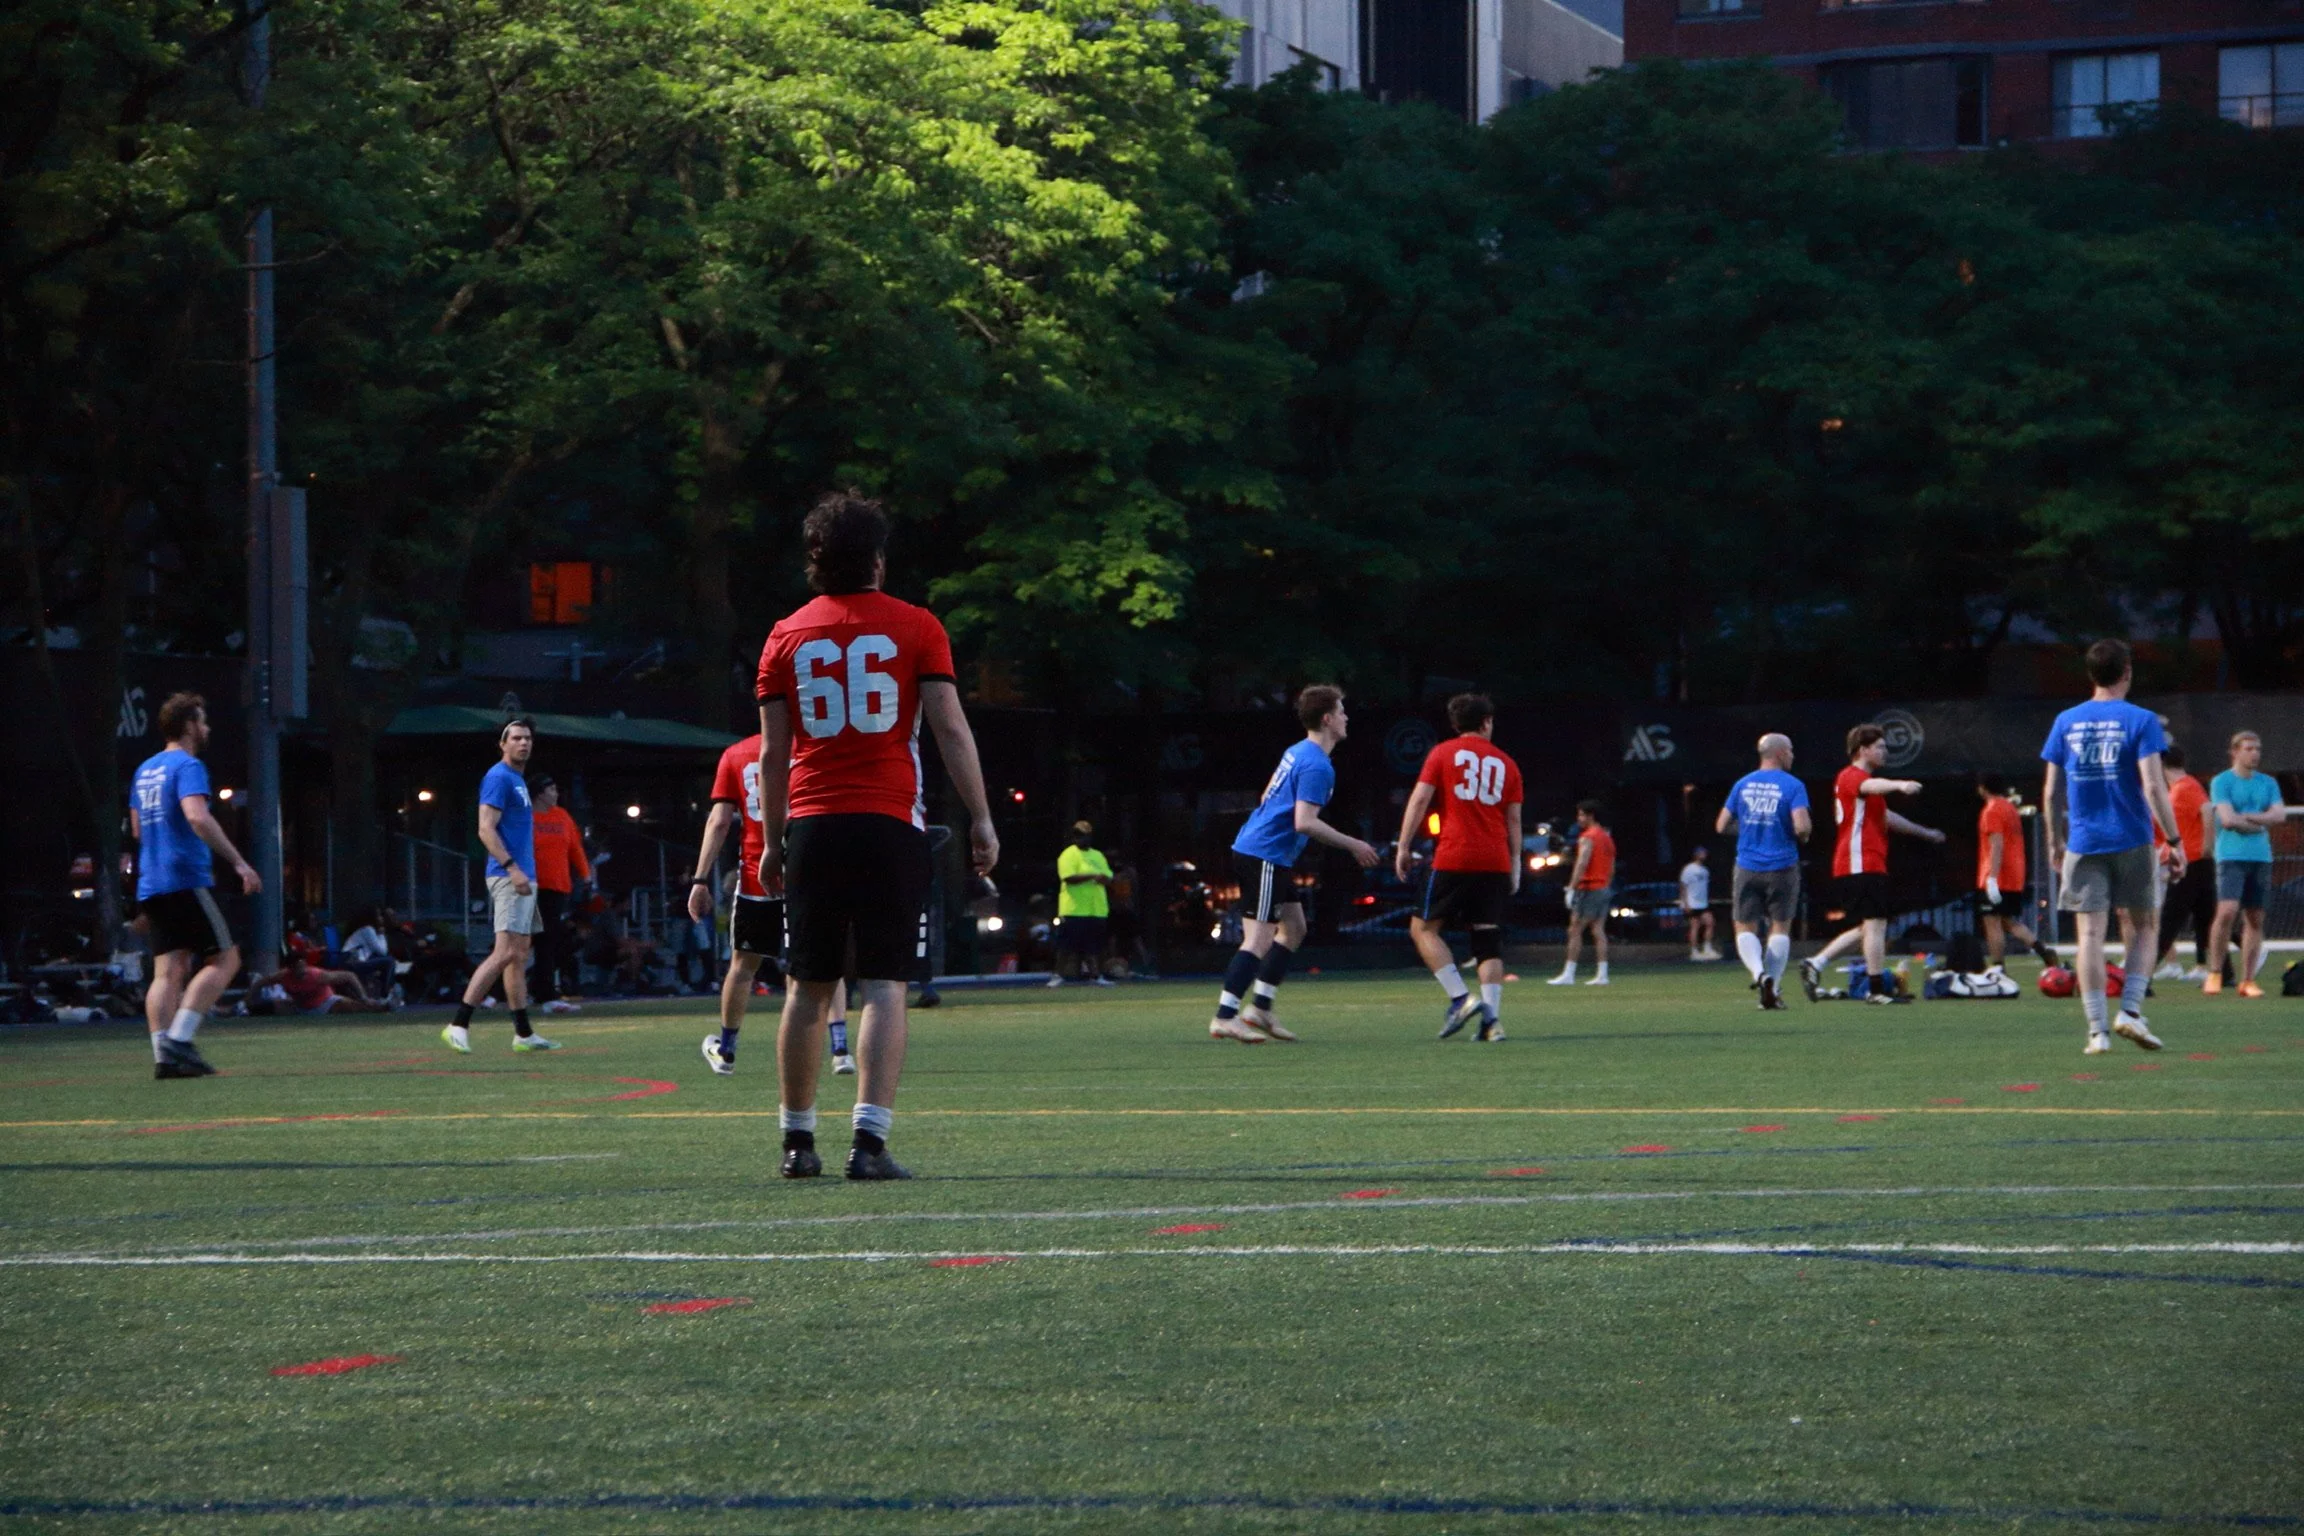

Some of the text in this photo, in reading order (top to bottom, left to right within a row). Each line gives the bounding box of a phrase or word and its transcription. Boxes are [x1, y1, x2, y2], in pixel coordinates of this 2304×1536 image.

[794, 634, 898, 738] 66
[1624, 723, 1676, 761] AG
[1454, 749, 1506, 806] 30
